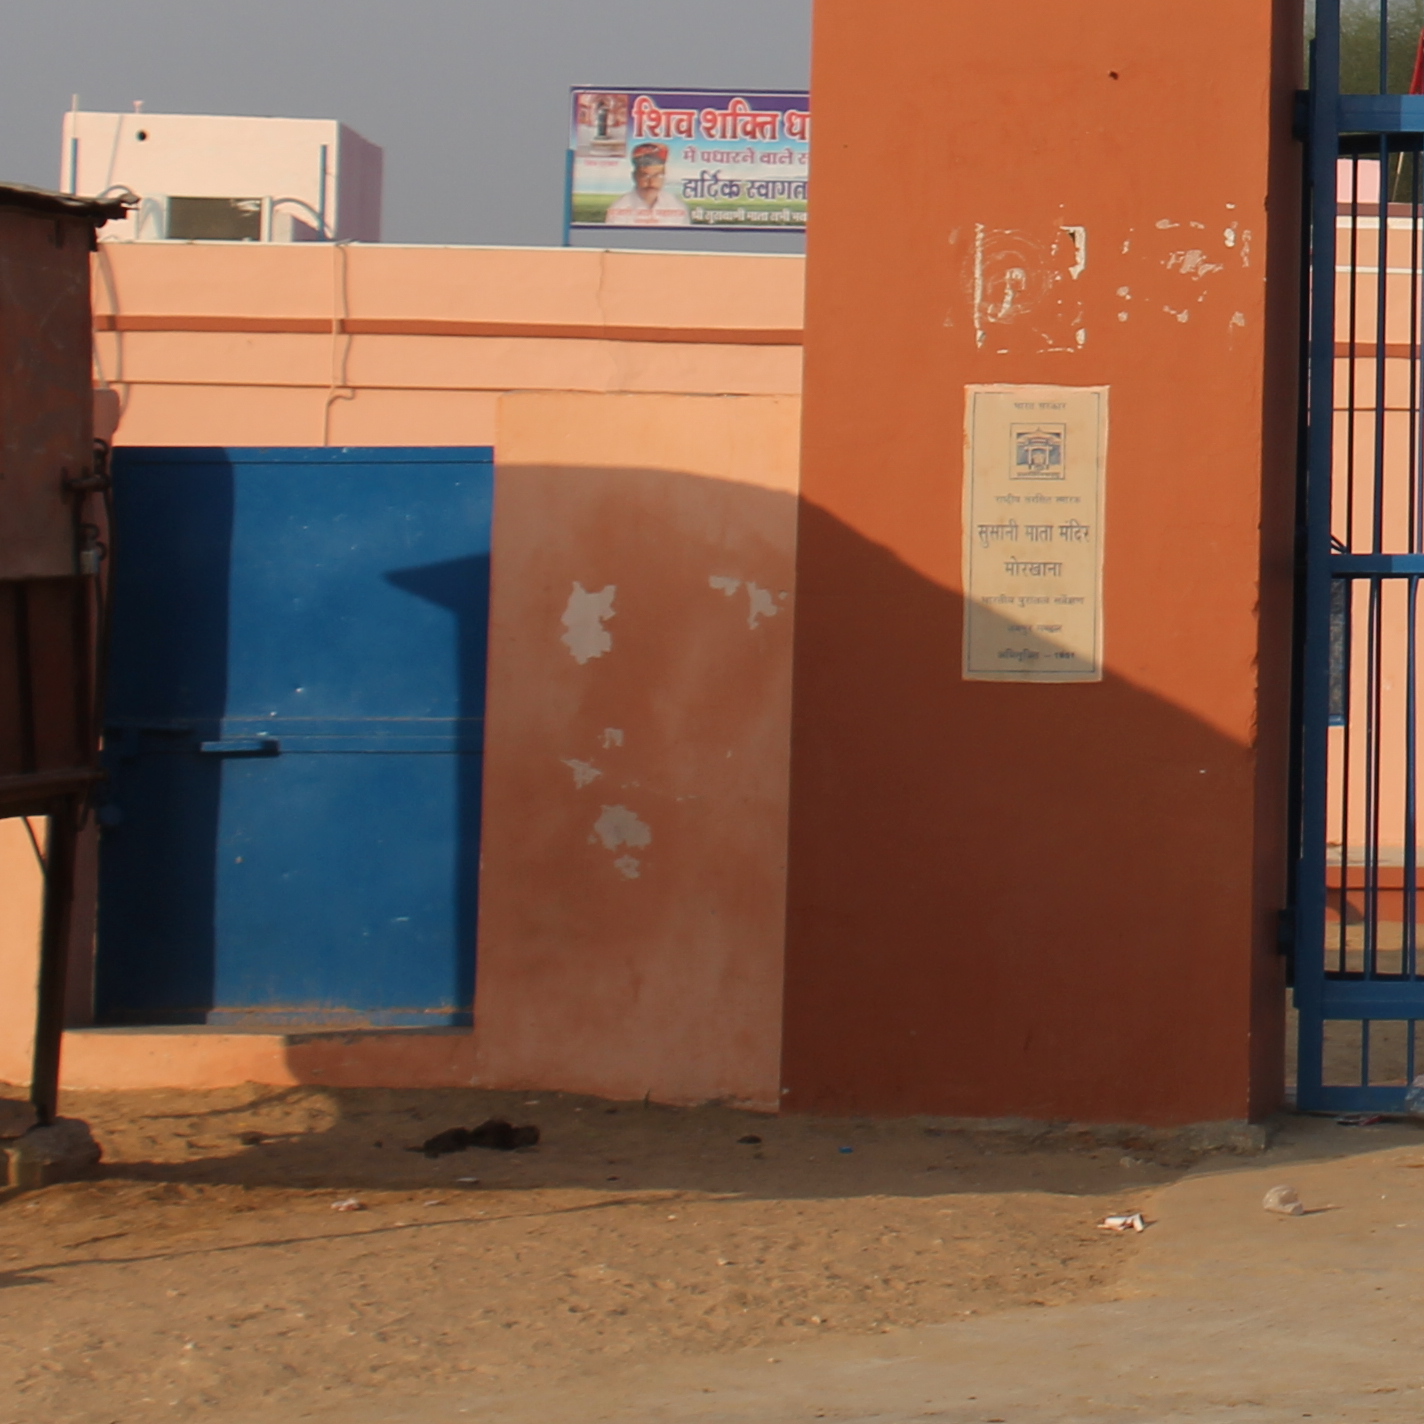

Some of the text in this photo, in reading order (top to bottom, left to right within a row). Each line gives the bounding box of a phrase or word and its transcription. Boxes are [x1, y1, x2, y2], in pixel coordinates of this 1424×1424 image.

[633, 95, 780, 141] शिव शक्ति
[701, 147, 756, 164] पधारने
[760, 147, 793, 165] वाले
[978, 519, 1090, 548] सुसानी माता मंदिर
[1003, 556, 1063, 577] मोरखाना
